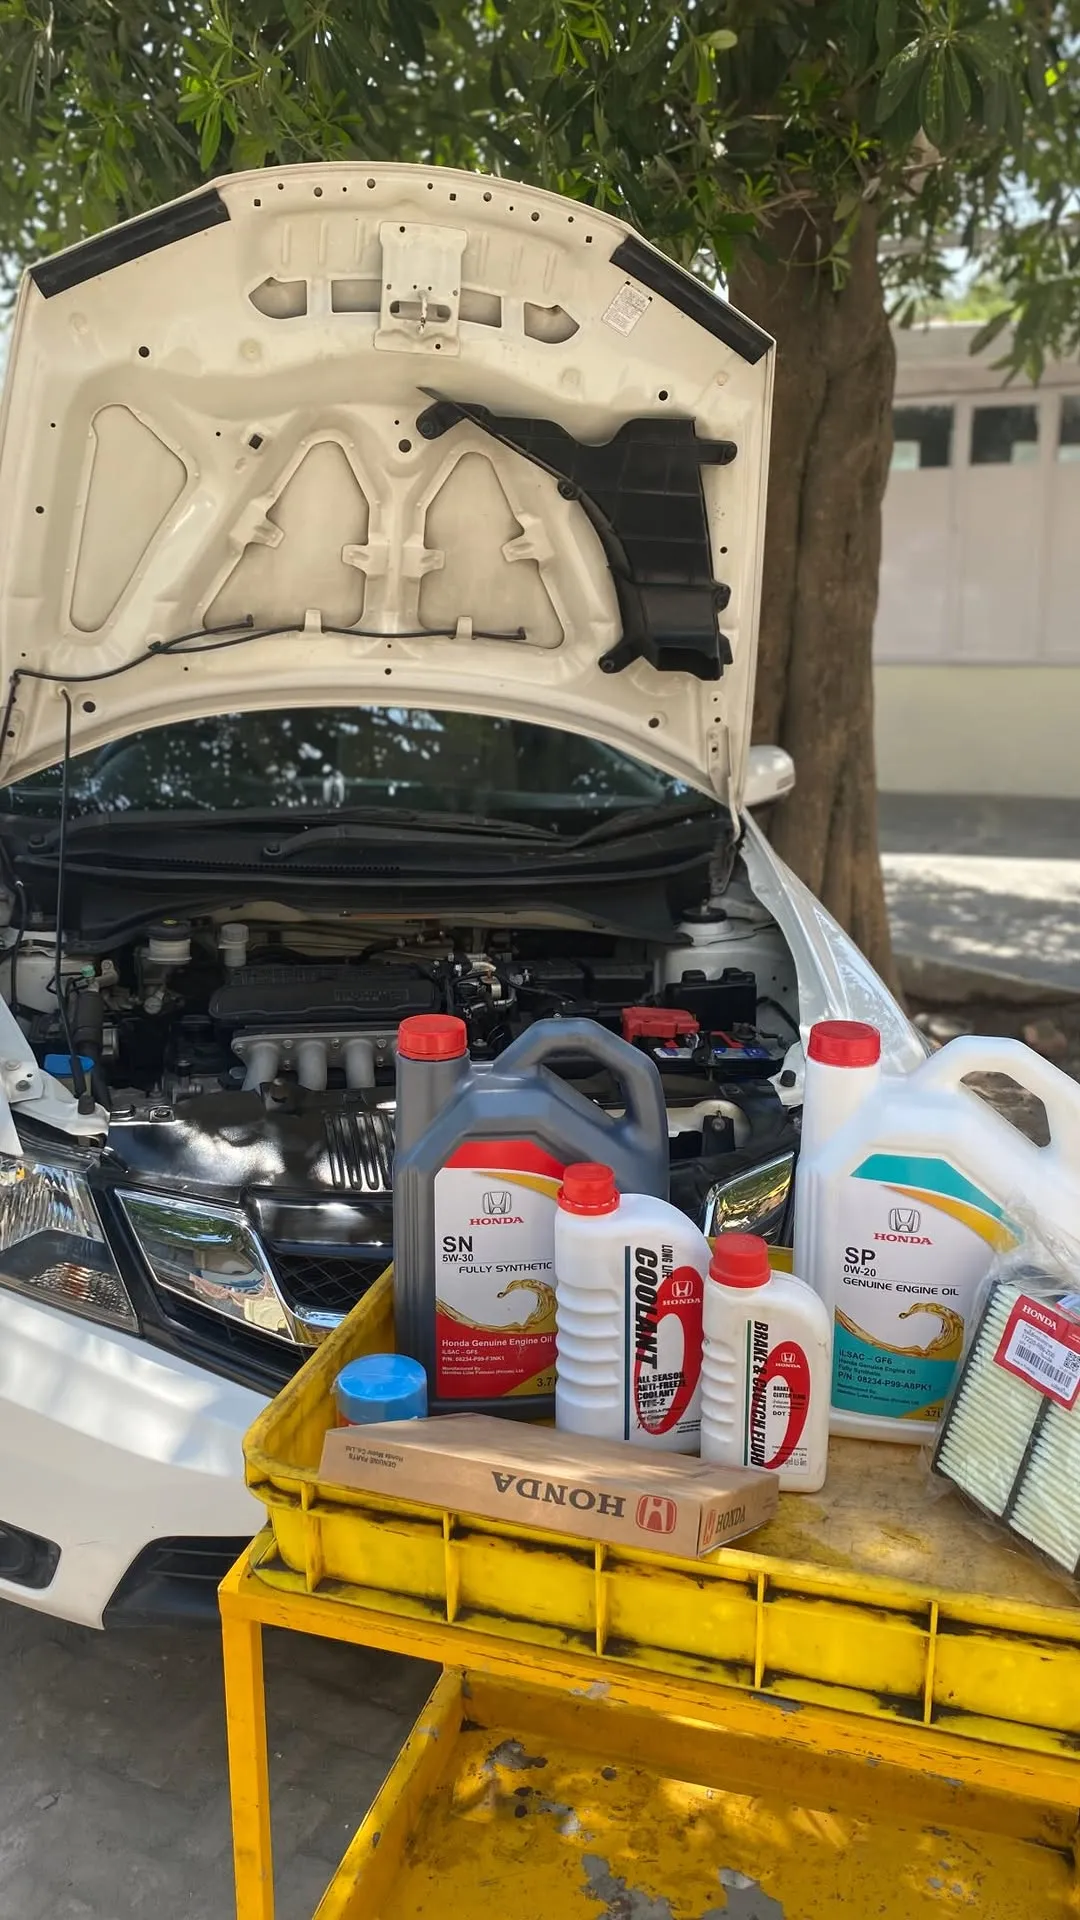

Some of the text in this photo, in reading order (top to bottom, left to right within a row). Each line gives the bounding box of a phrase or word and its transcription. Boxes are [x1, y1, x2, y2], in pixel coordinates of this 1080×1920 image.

[469, 1216, 524, 1226] HONDA
[442, 1235, 473, 1253] SN
[873, 1232, 933, 1245] HONDA
[442, 1253, 474, 1263] 5W-30
[661, 1244, 675, 1263] LONG
[844, 1246, 876, 1266] SP
[458, 1261, 553, 1274] FULLY SYNTHETIC
[843, 1264, 877, 1277] 0W-20
[842, 1276, 960, 1296] GENUINE ENGINE OIL
[634, 1246, 659, 1370] COOLANT
[662, 1298, 702, 1306] HONDA
[1021, 1304, 1057, 1331] HONDA
[441, 1335, 553, 1347] Honda Genuine Engine Oil
[637, 1375, 651, 1384] ALL
[637, 1389, 675, 1400] COOLANT
[750, 1320, 769, 1467] BRAKE & CLUTCH FLUID
[491, 1471, 626, 1519] HONDA
[714, 1504, 747, 1534] HONDA
